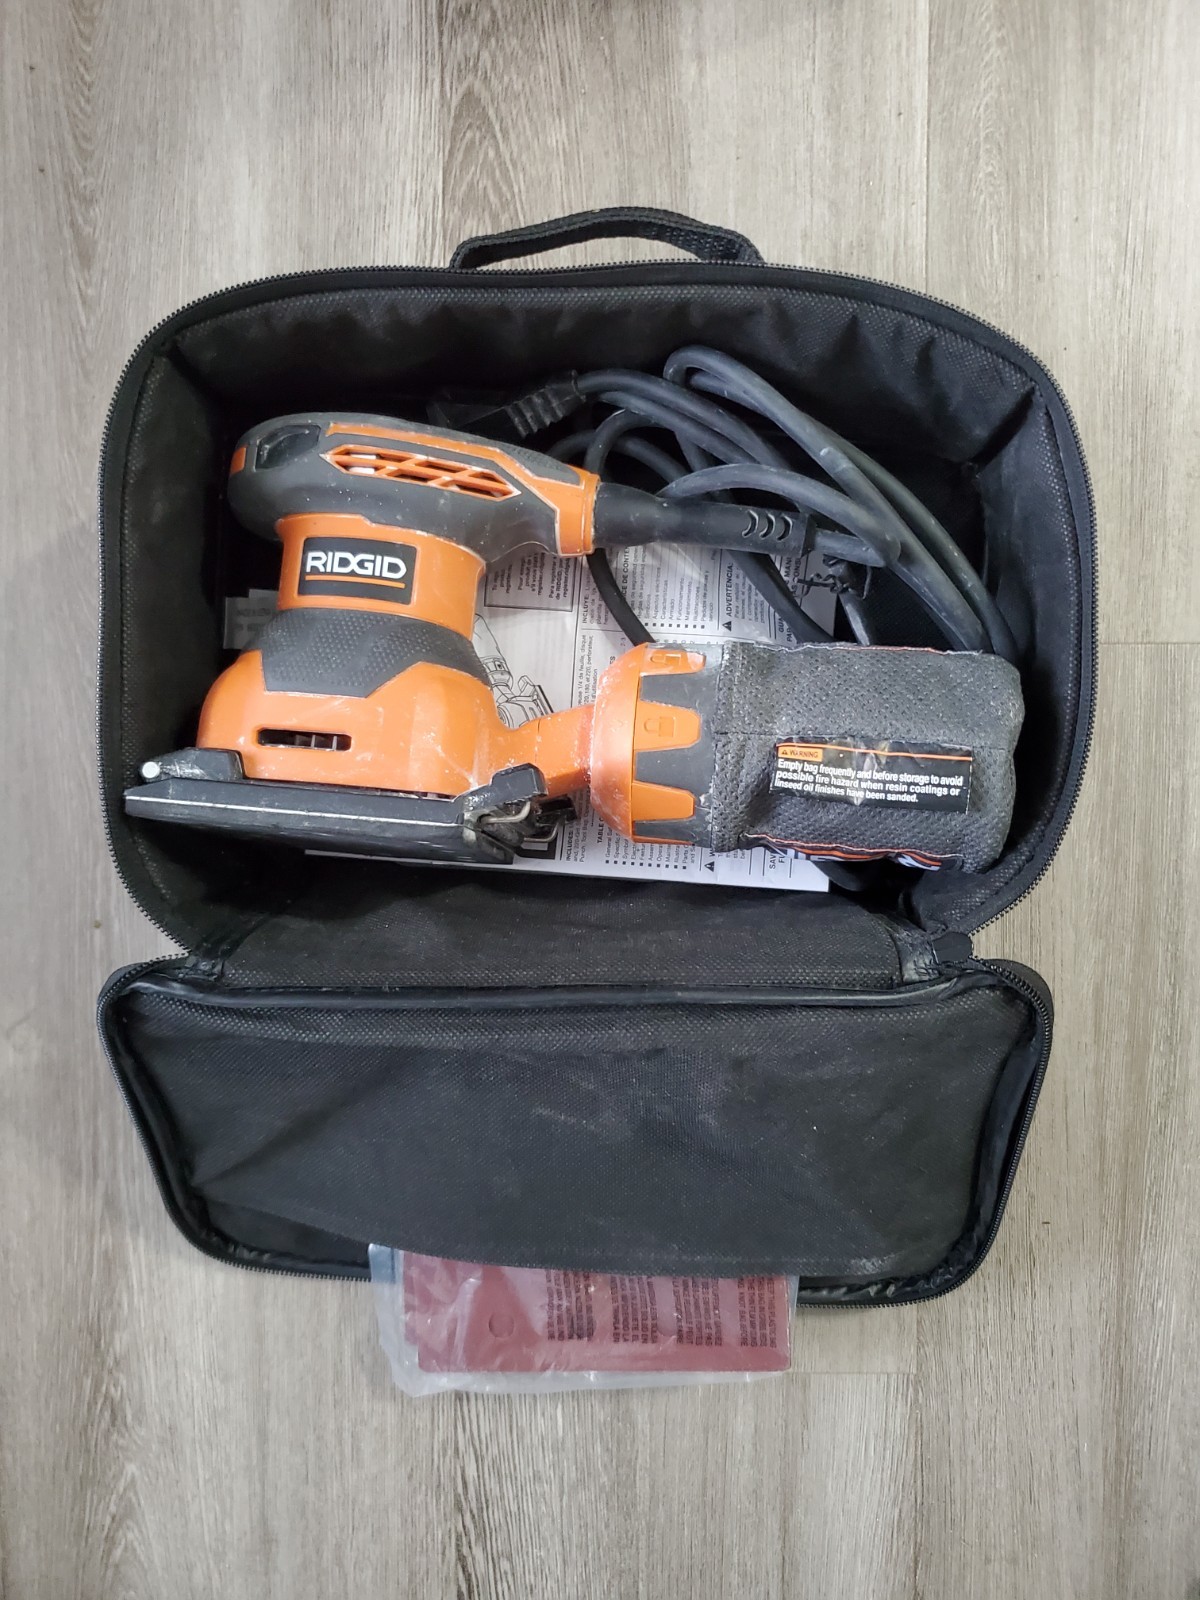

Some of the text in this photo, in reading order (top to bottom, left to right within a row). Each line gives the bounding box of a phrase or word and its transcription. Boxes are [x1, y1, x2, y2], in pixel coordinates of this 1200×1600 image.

[306, 551, 407, 579] RIDGID
[789, 750, 818, 758] WARNING
[776, 770, 960, 797] possible fire hazard when resin coatings or
[778, 759, 963, 786] Empty bag frequently and before storage to avoid
[774, 779, 919, 802] linseed oil finishes have been sanded.
